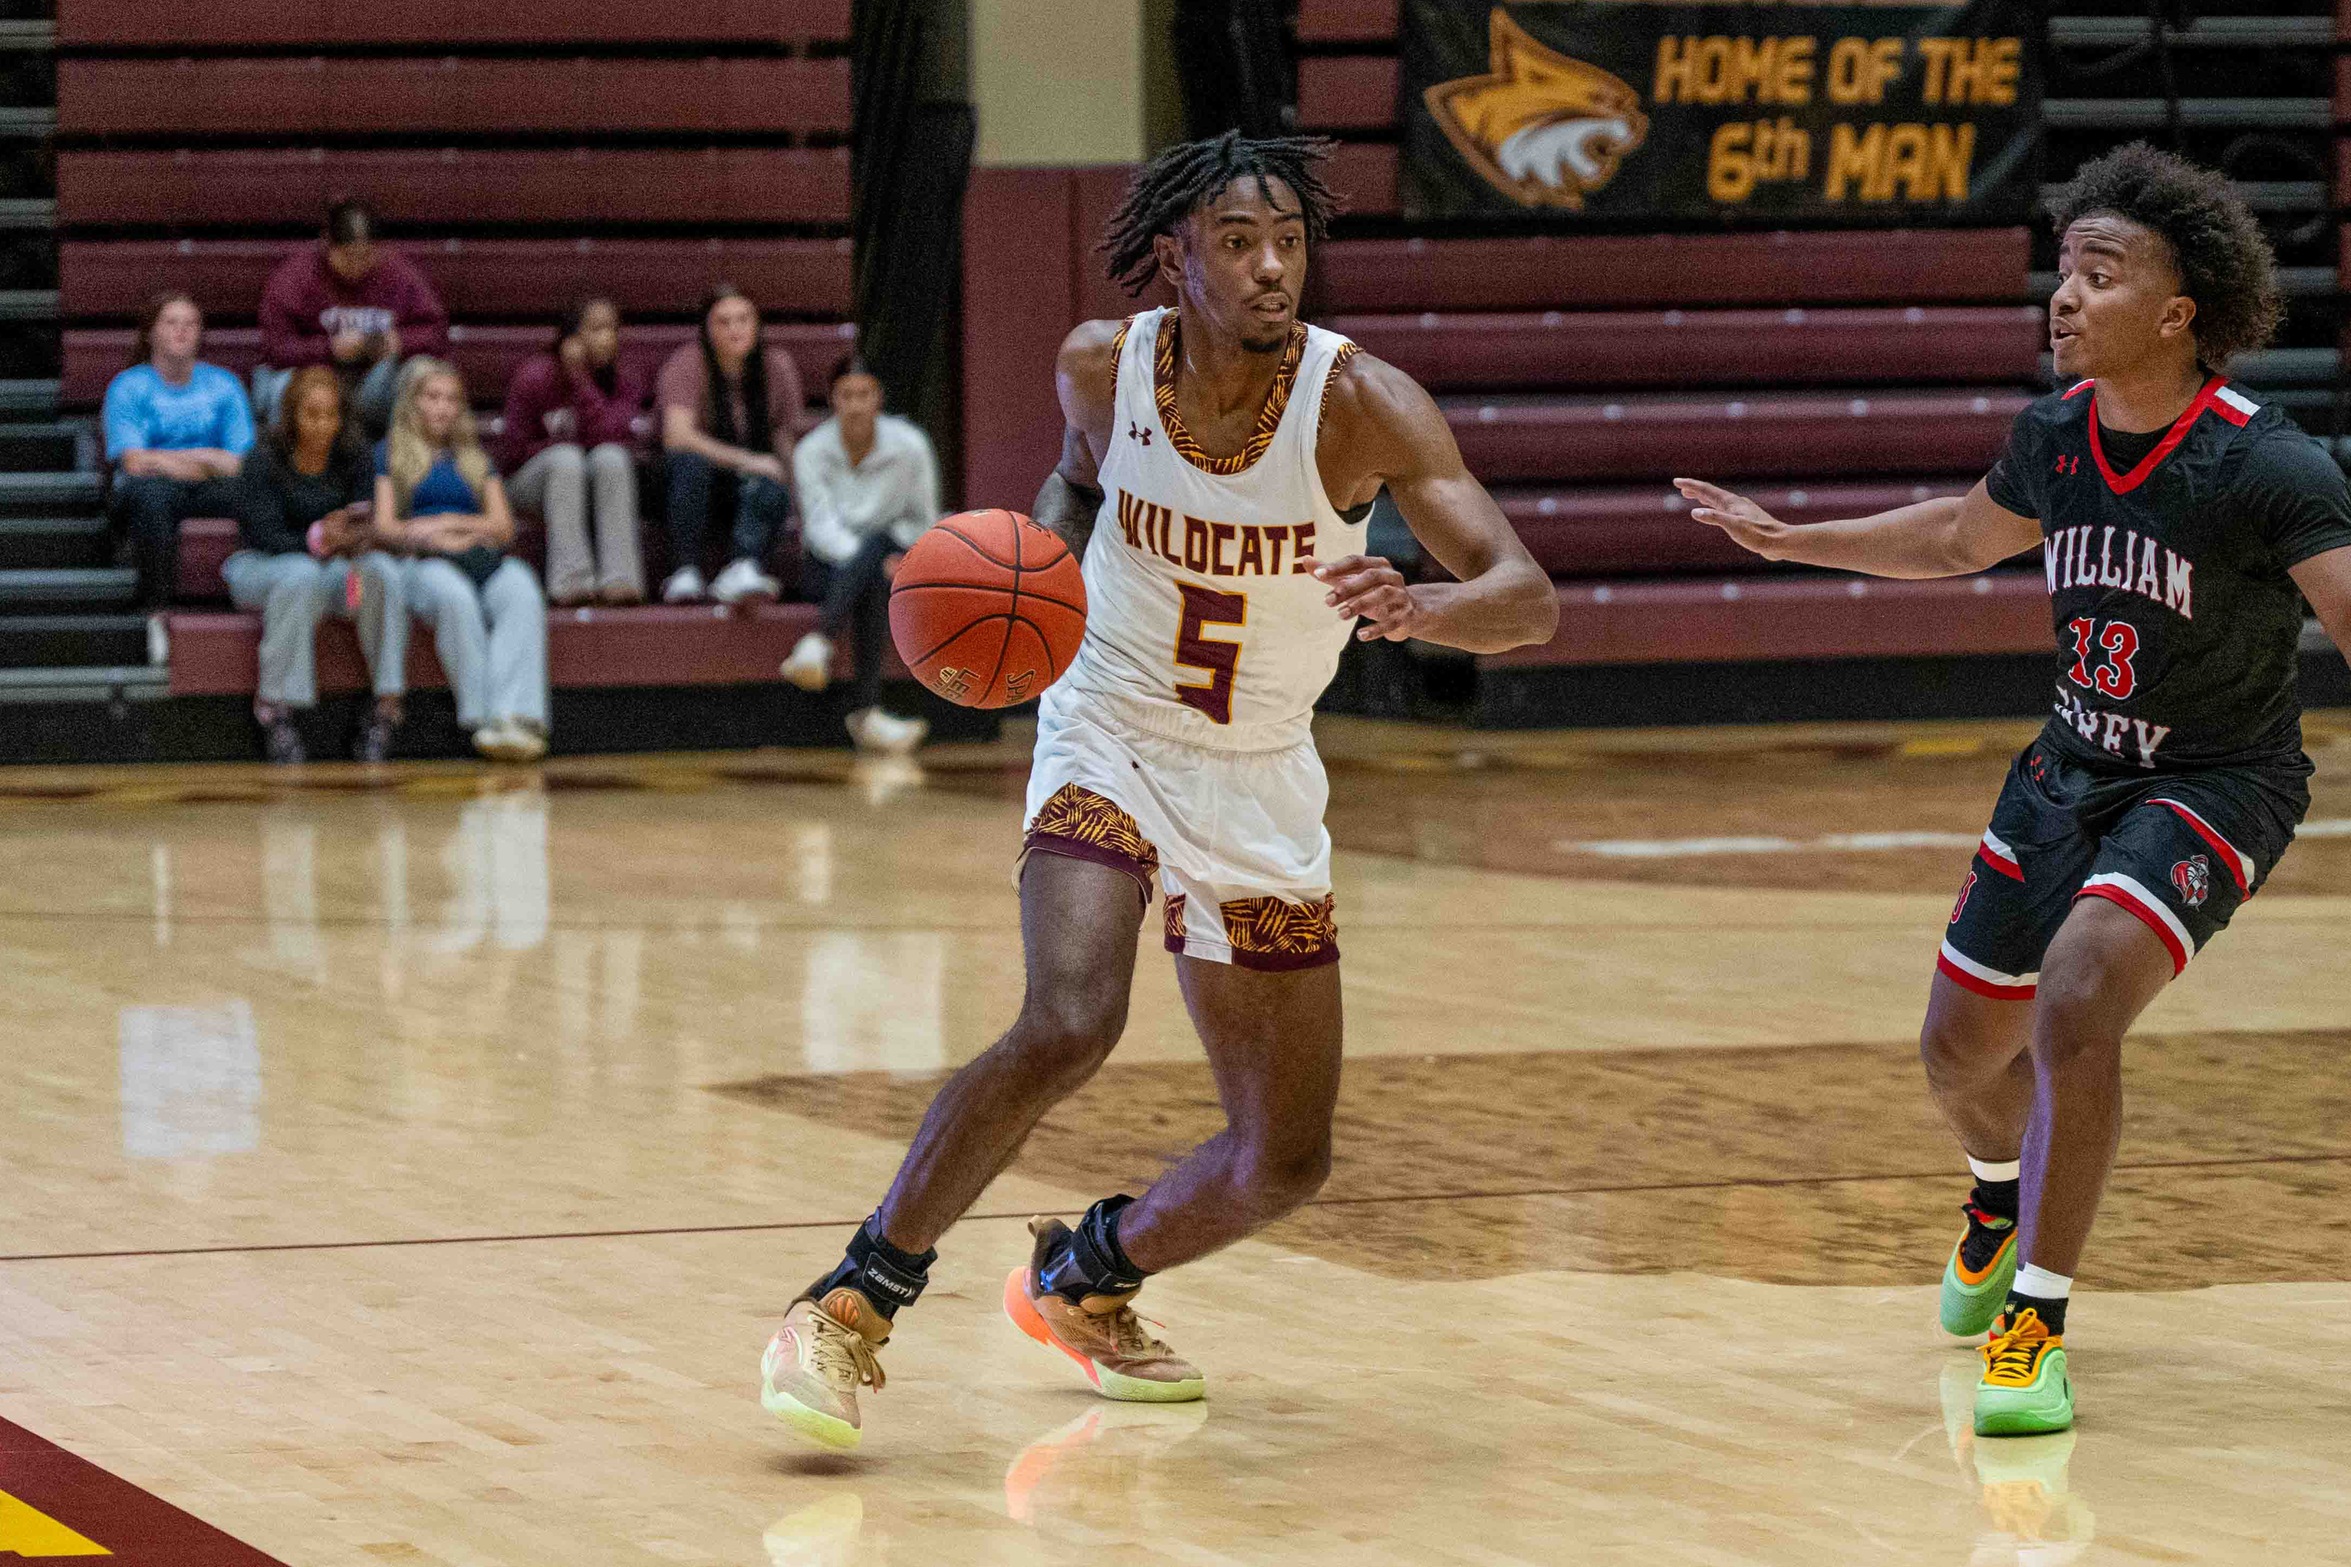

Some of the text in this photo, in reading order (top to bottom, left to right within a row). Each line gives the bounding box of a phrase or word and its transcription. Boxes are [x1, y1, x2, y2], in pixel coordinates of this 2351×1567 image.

[1655, 36, 2021, 104] HOME OF THE
[1707, 117, 1976, 202] 6th MAN
[1118, 488, 1316, 577] WILDCATS
[2044, 525, 2194, 621] WILLIAM
[1173, 579, 1248, 725] 5
[2068, 616, 2140, 700] 13
